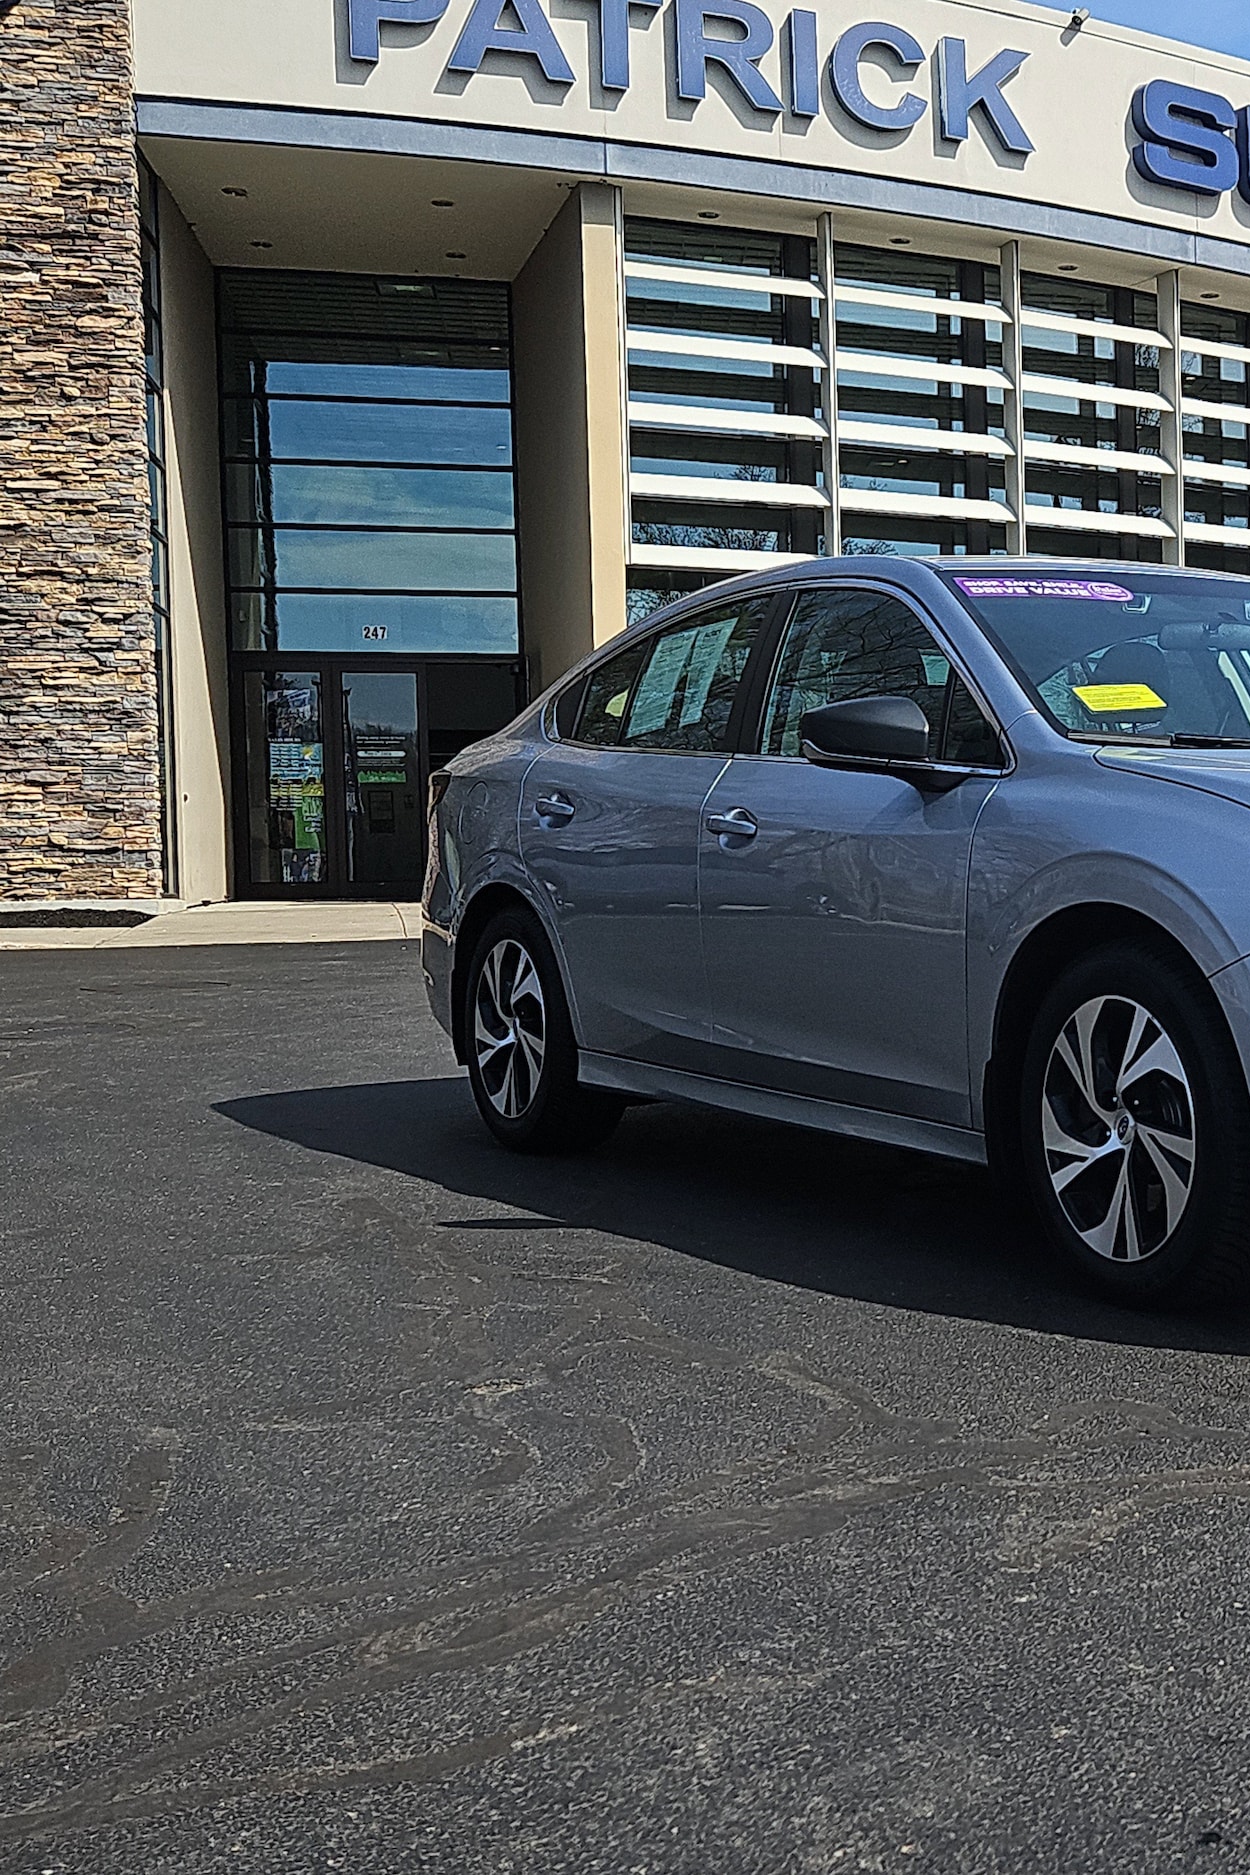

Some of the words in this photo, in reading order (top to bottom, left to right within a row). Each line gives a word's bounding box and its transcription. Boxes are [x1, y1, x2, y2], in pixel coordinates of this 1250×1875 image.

[349, 0, 1035, 152] PATRICK
[968, 586, 1028, 594] DRIVE
[1028, 587, 1092, 597] VALUE
[363, 626, 387, 640] 247
